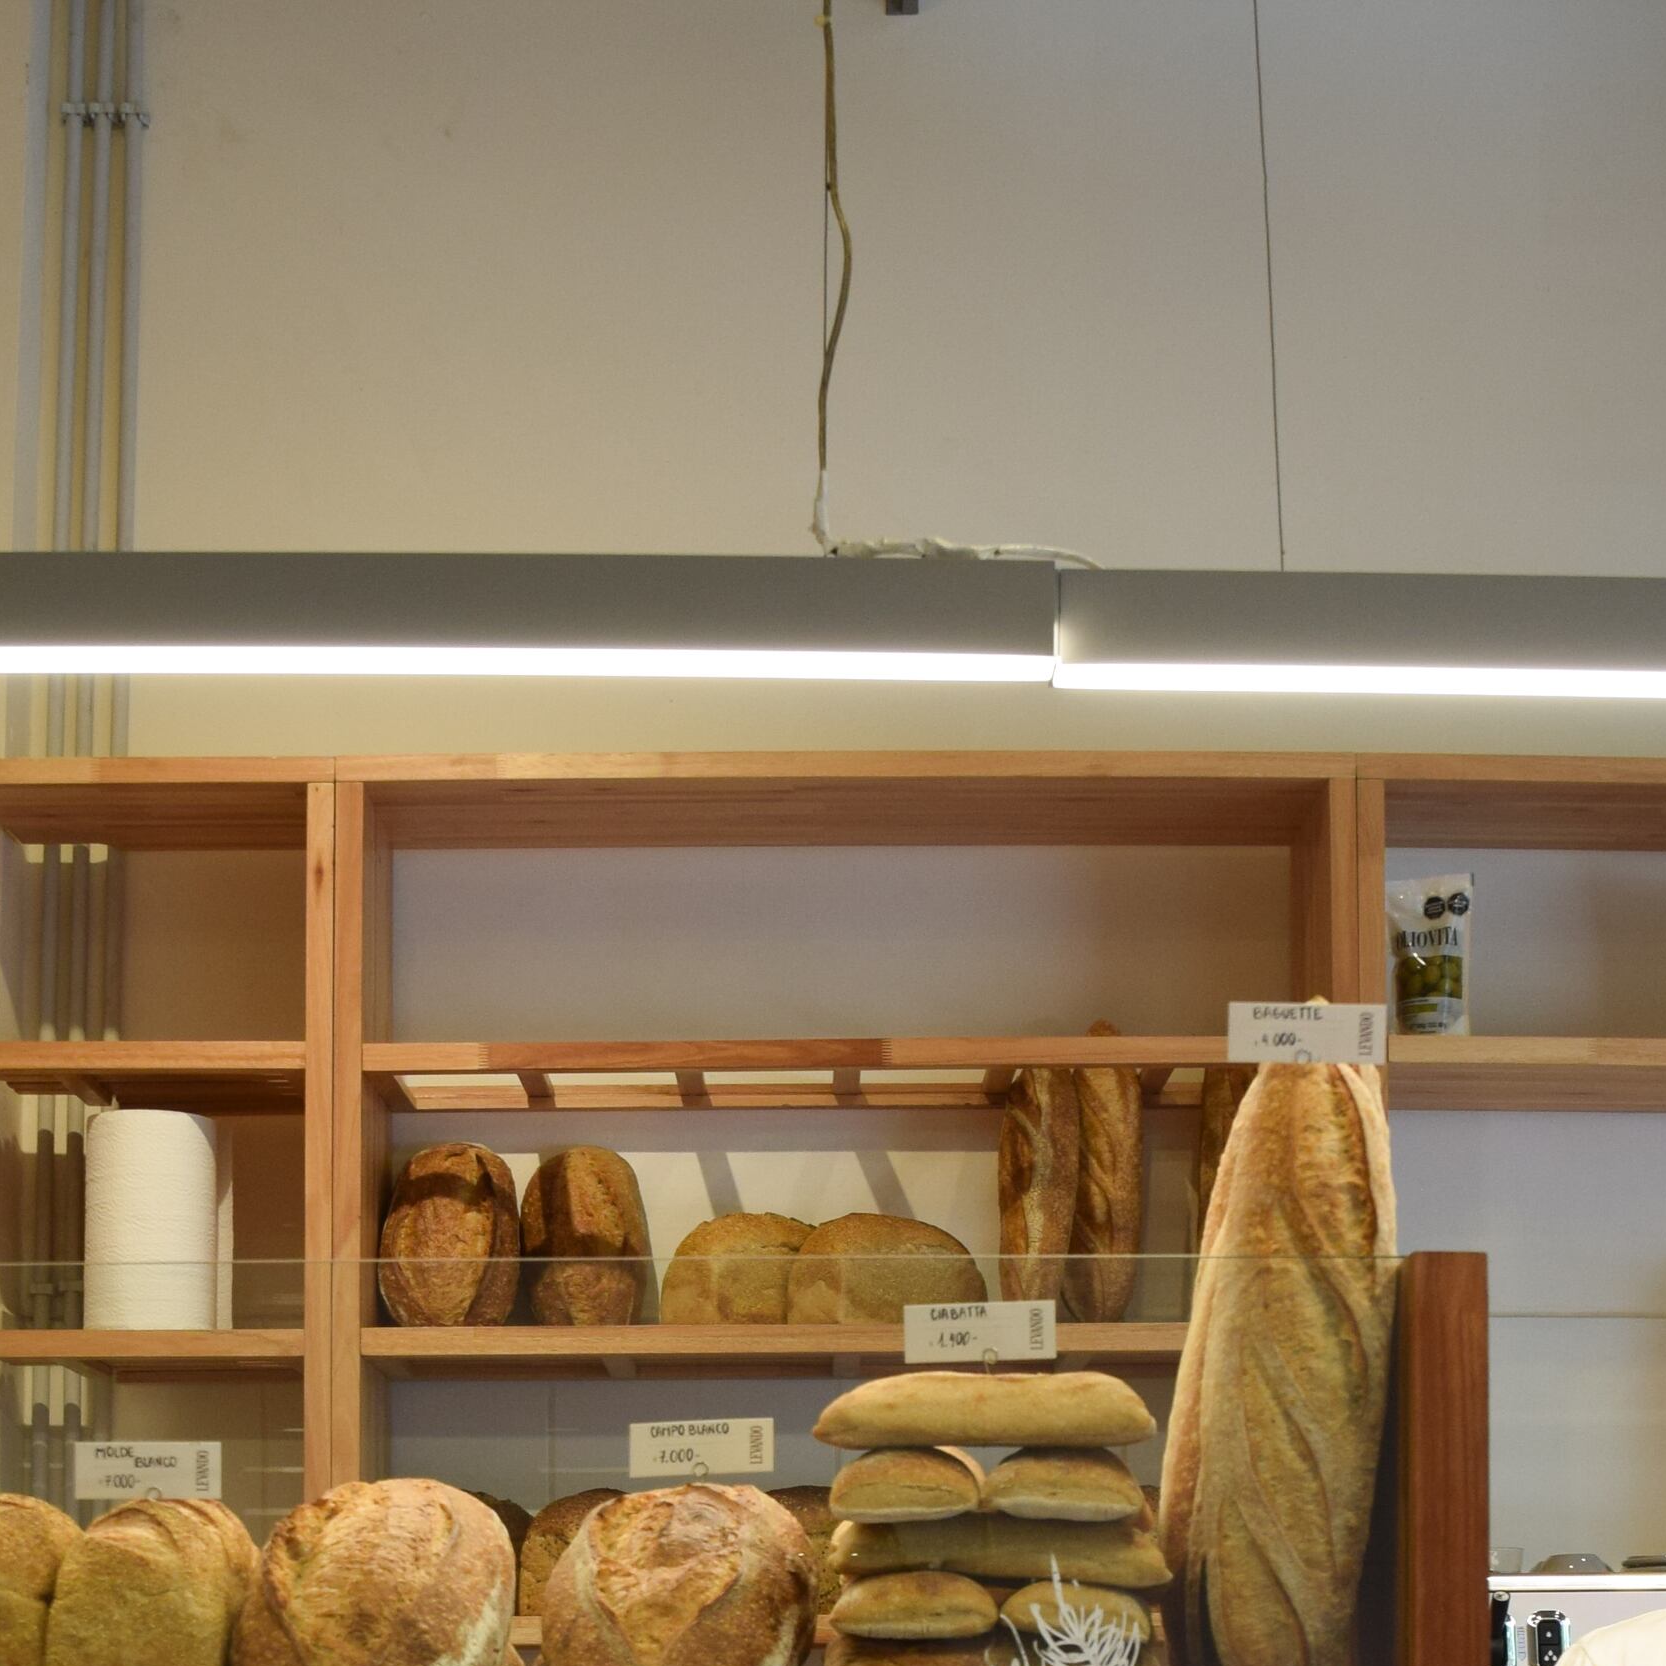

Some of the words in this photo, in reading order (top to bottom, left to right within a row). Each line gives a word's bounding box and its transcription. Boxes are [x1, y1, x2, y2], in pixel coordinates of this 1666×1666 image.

[1252, 1006, 1324, 1021] BAGUETTE
[1358, 1012, 1375, 1056] LEVANDO
[929, 1306, 988, 1321] CIABATTA
[1029, 1308, 1044, 1351] LEVANDO
[649, 1423, 684, 1439] CAMPO
[688, 1422, 730, 1436] BLANCO
[94, 1446, 134, 1459] MOLDE
[749, 1424, 764, 1465] LEVANDO
[134, 1455, 178, 1469] BLANCO
[196, 1449, 211, 1492] LEVANDO
